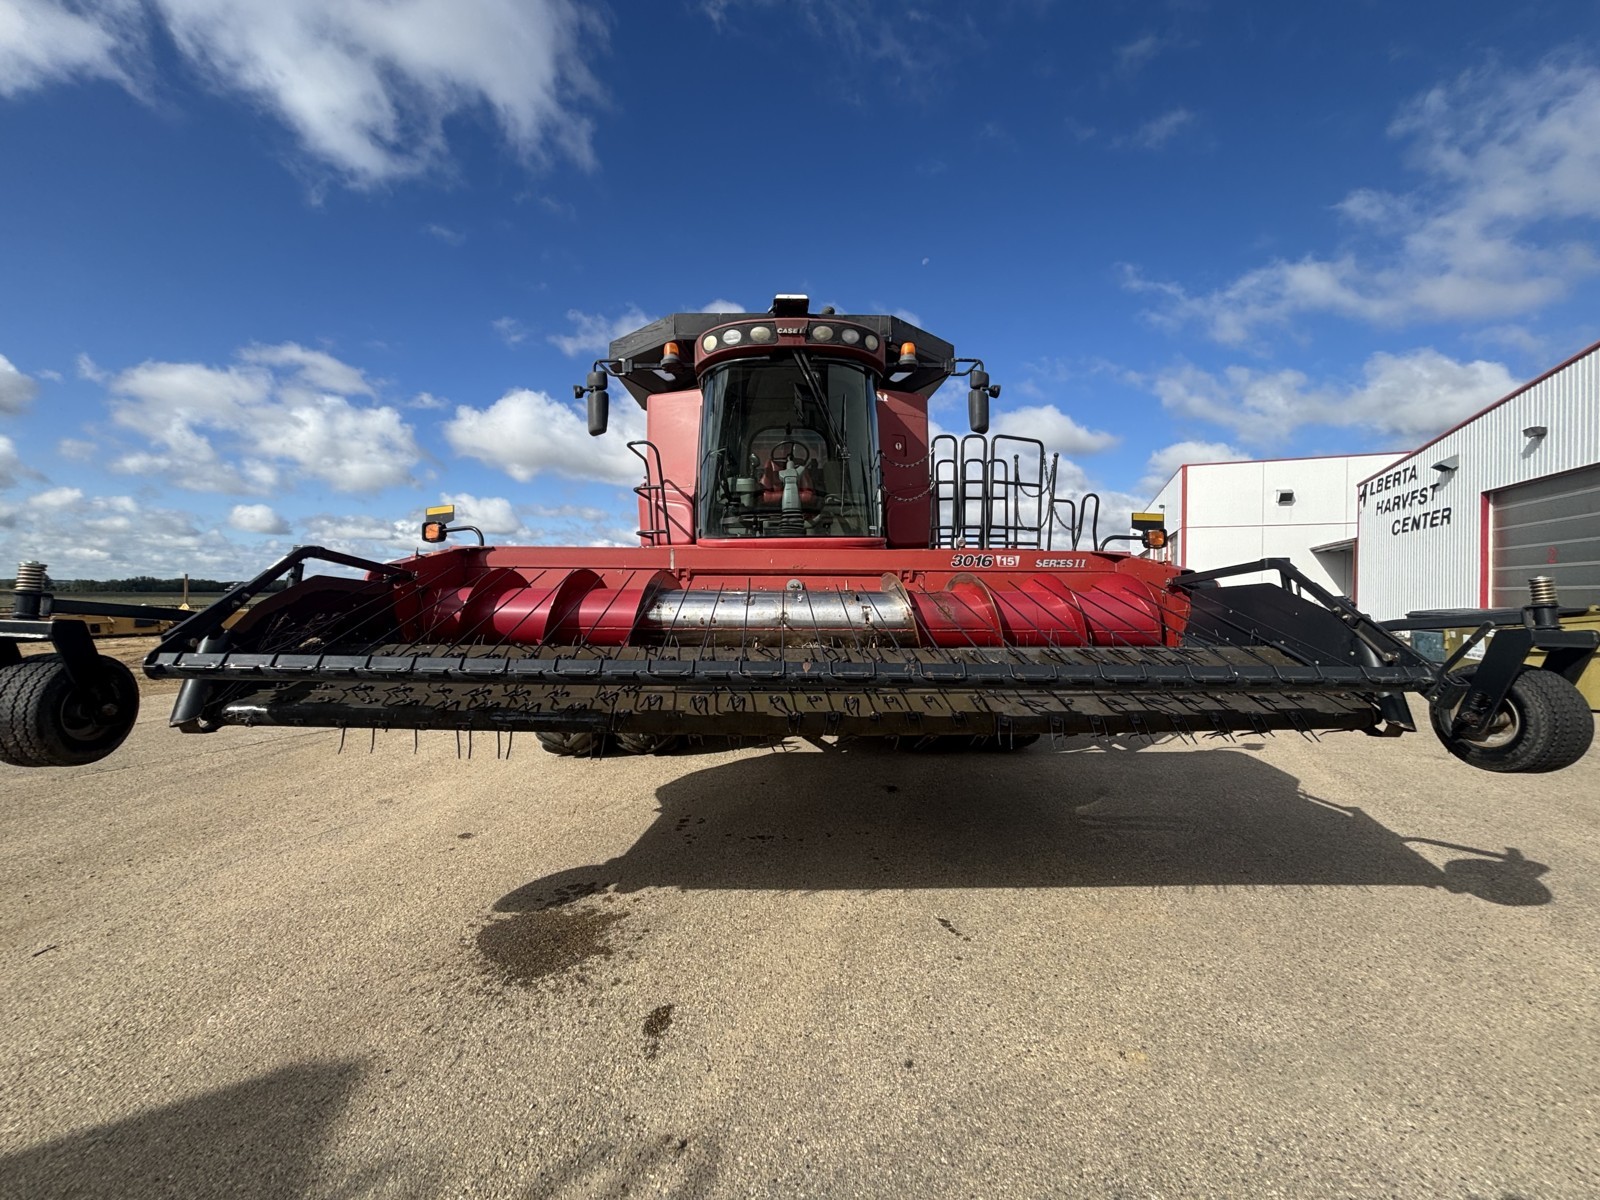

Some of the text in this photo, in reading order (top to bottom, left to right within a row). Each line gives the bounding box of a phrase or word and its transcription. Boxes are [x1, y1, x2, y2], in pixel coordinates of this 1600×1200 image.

[1359, 464, 1418, 508] ALBERTA
[1391, 507, 1452, 536] CENTER
[951, 554, 994, 568] 3016
[1074, 559, 1086, 568] II
